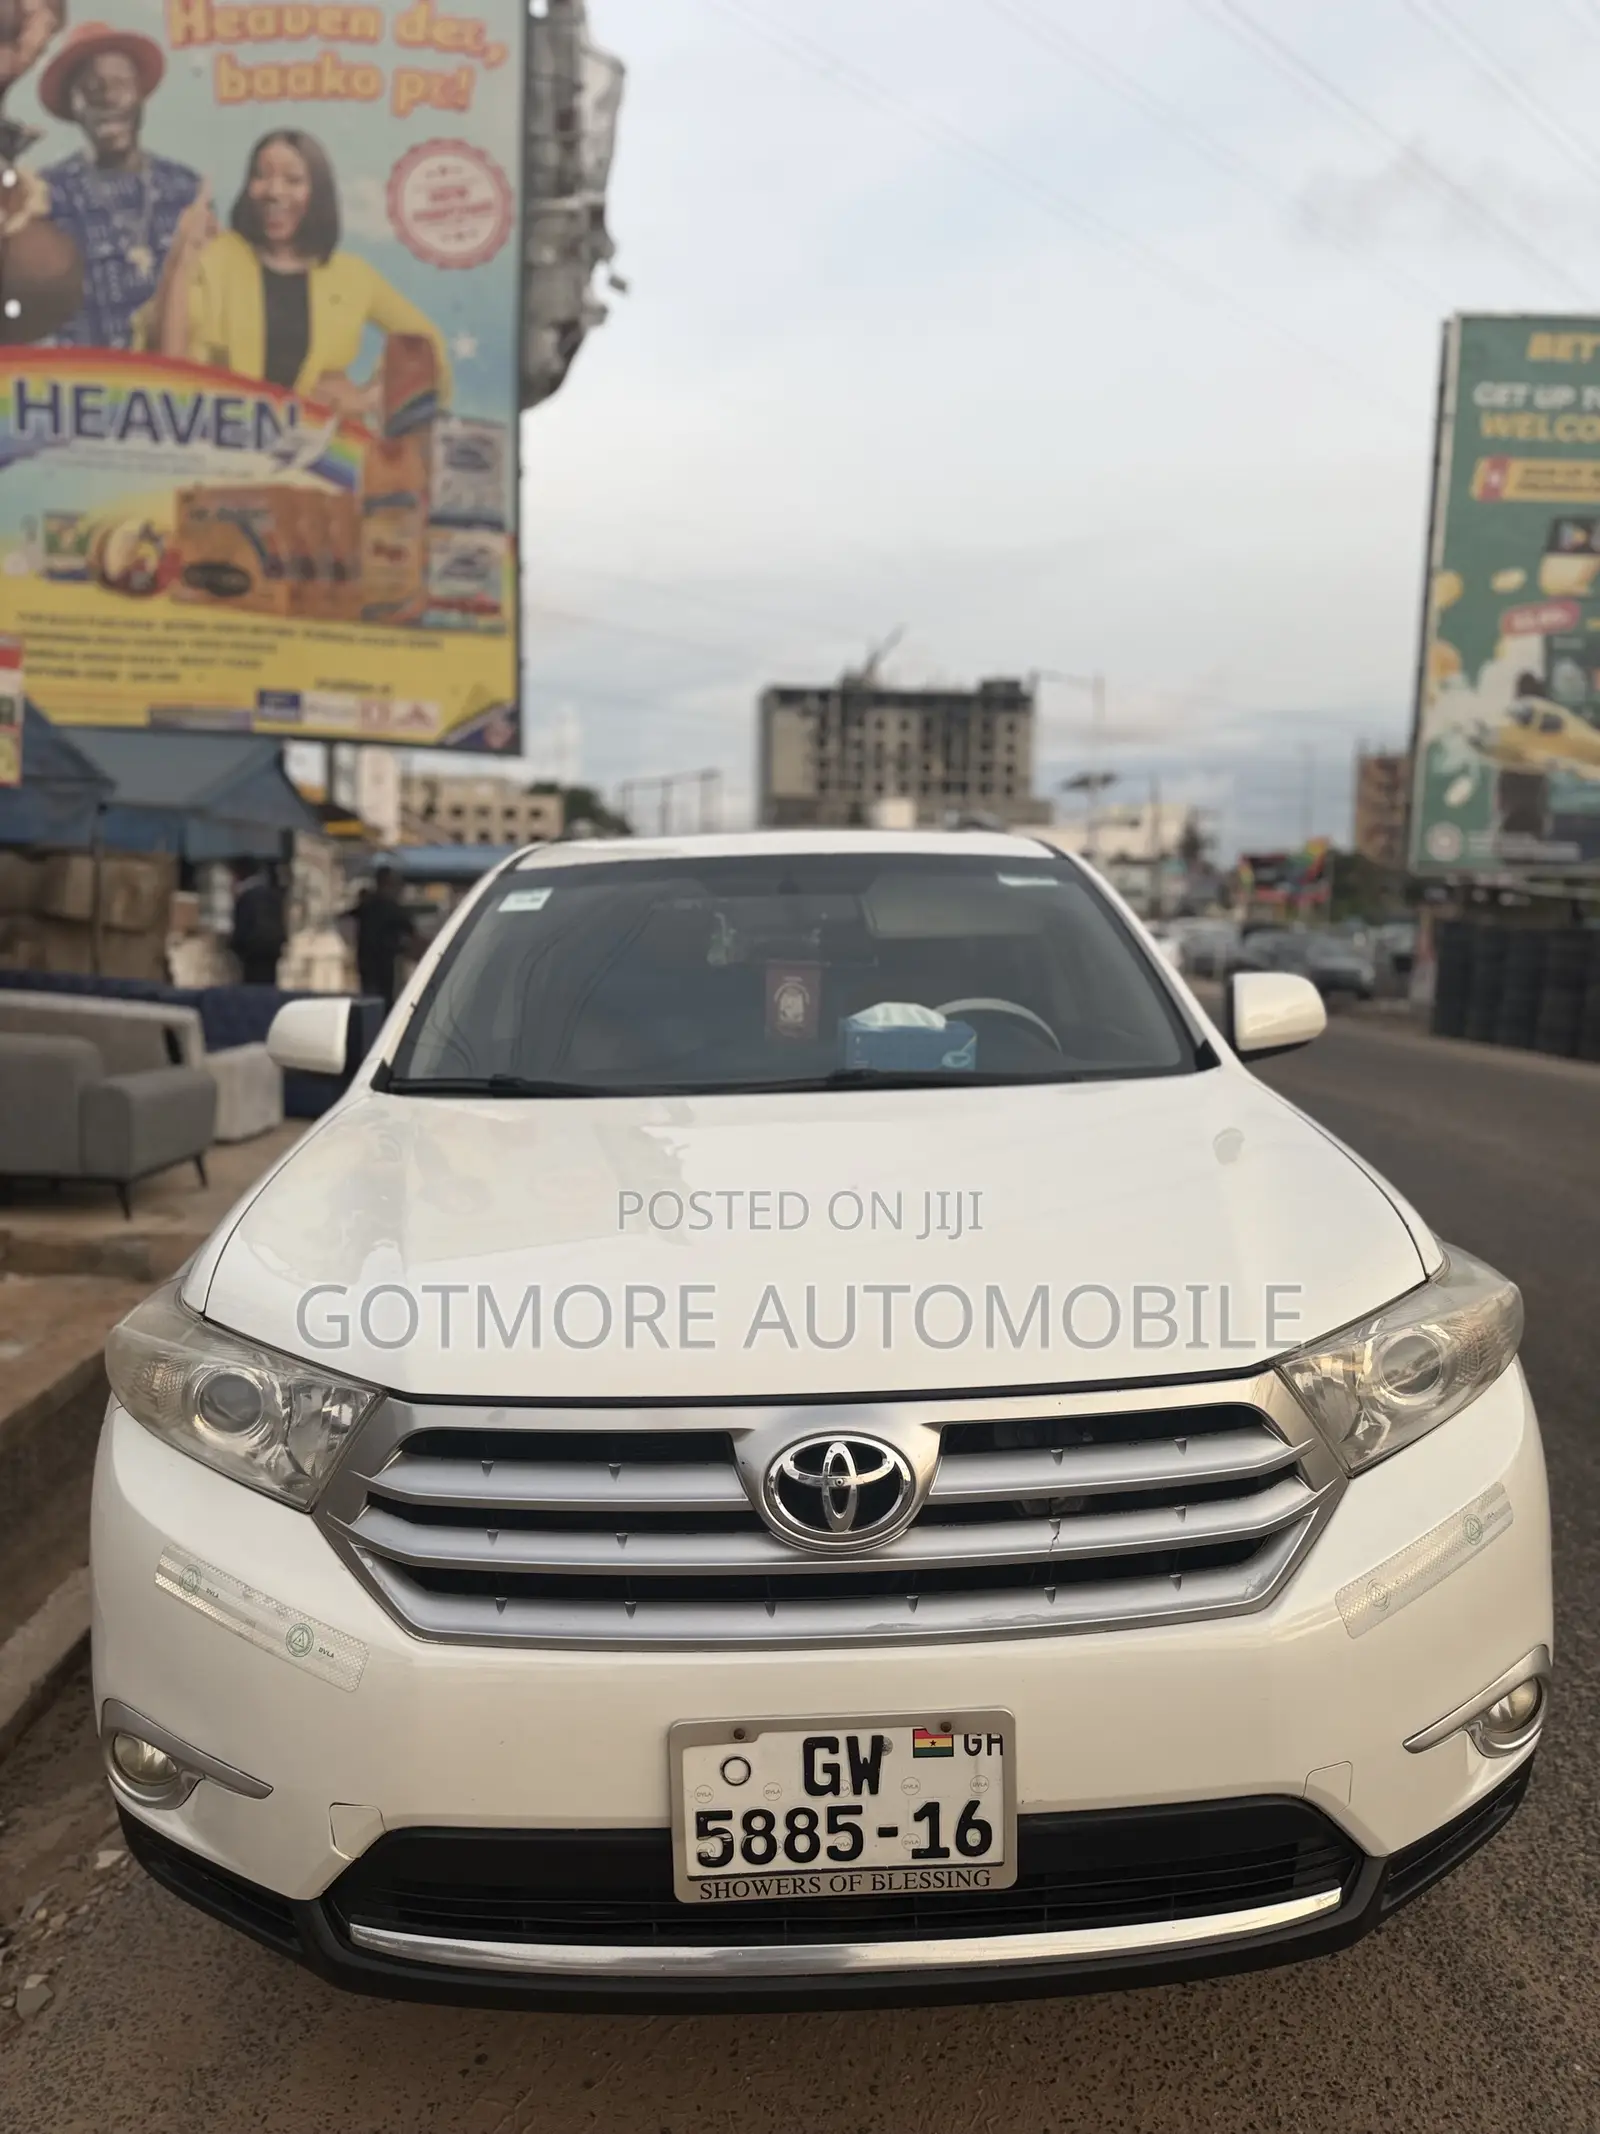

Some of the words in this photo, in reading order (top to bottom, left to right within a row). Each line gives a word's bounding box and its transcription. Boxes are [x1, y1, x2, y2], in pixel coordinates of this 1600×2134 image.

[167, 0, 382, 46] Heaven
[214, 50, 384, 106] baako
[14, 379, 298, 450] HEAVEN
[802, 1734, 884, 1797] GW
[963, 1733, 1004, 1757] GH
[695, 1799, 993, 1868] 5885-16
[700, 1875, 821, 1900] SHOWERS
[829, 1874, 863, 1893] OF
[871, 1868, 992, 1892] BLESSING
